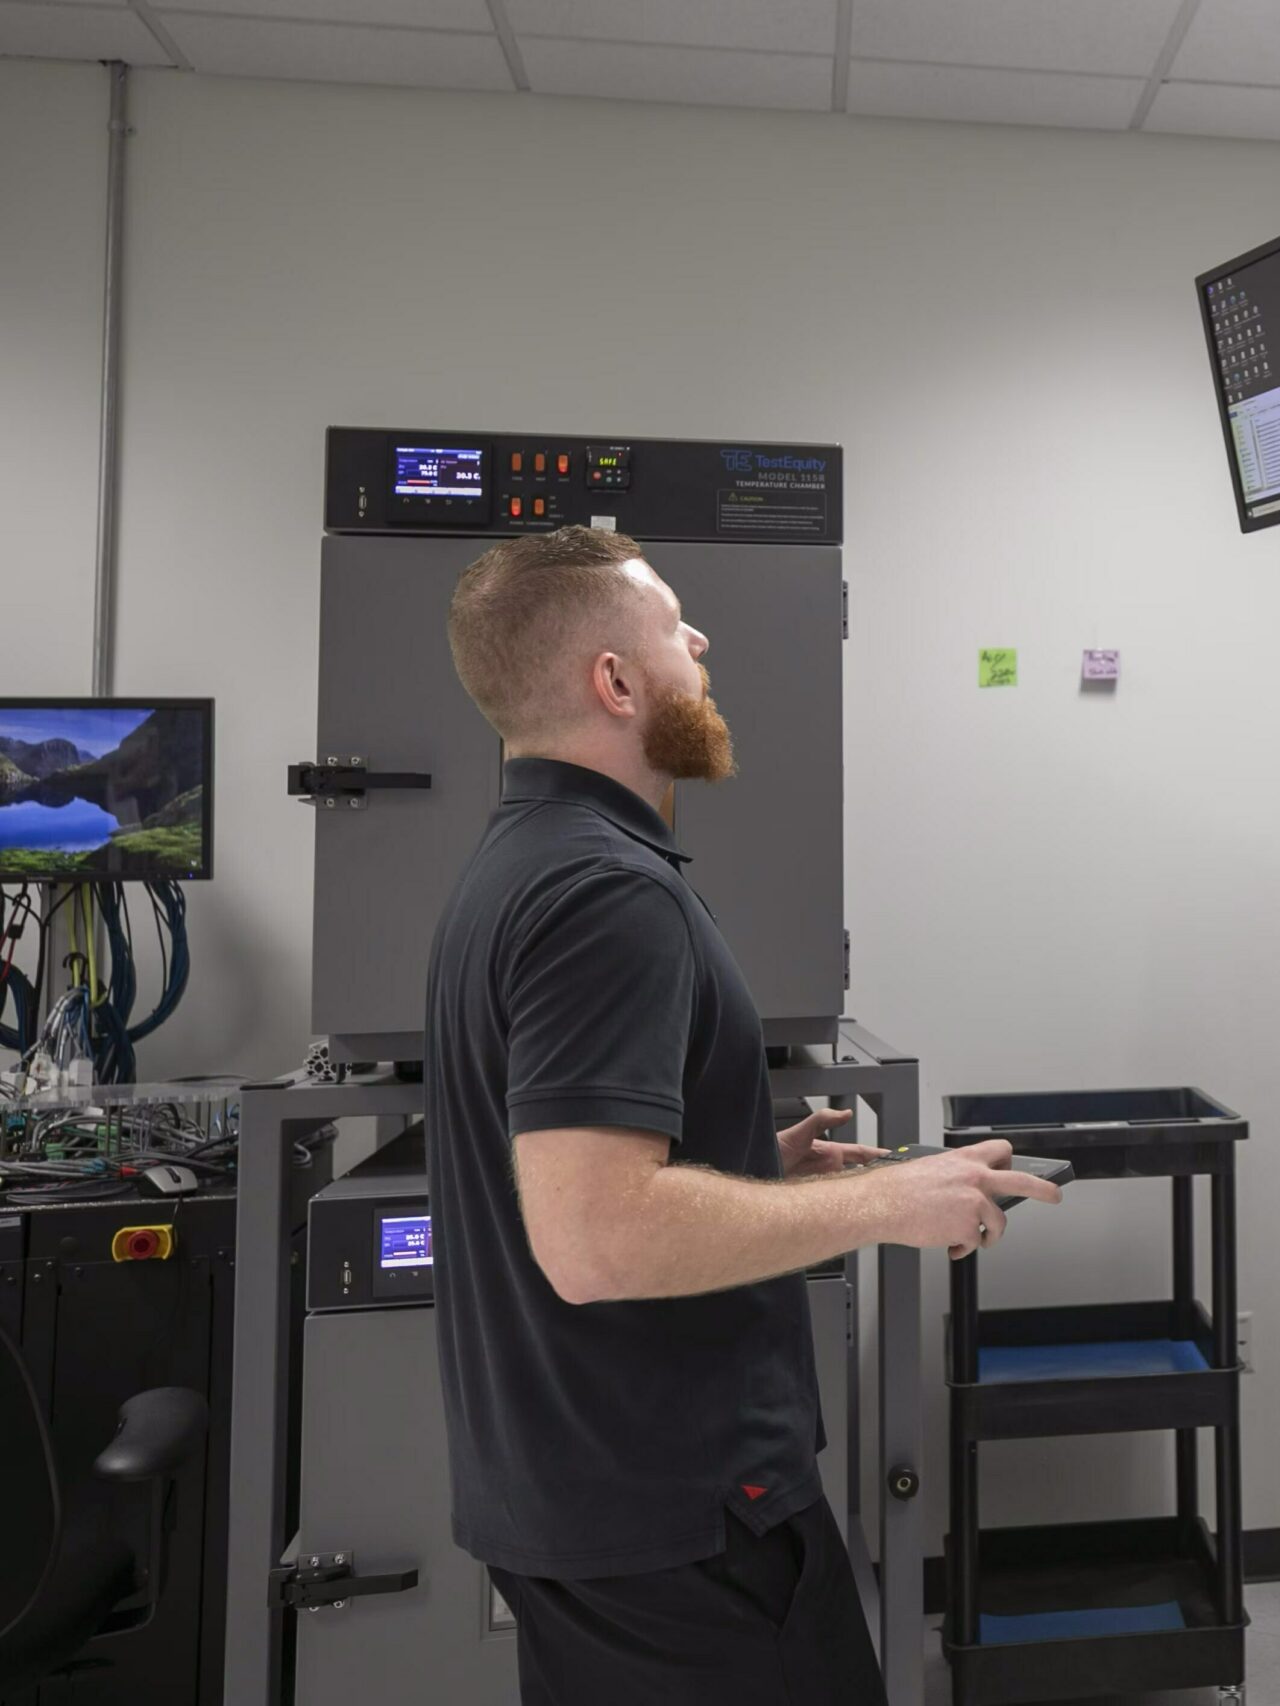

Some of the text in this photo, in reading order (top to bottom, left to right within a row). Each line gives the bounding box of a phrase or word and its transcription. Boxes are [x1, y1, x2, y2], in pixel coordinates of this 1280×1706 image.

[755, 454, 826, 472] TestEquity
[758, 472, 797, 481] MODEL
[736, 480, 826, 490] TEMPERATURE CHAMBER
